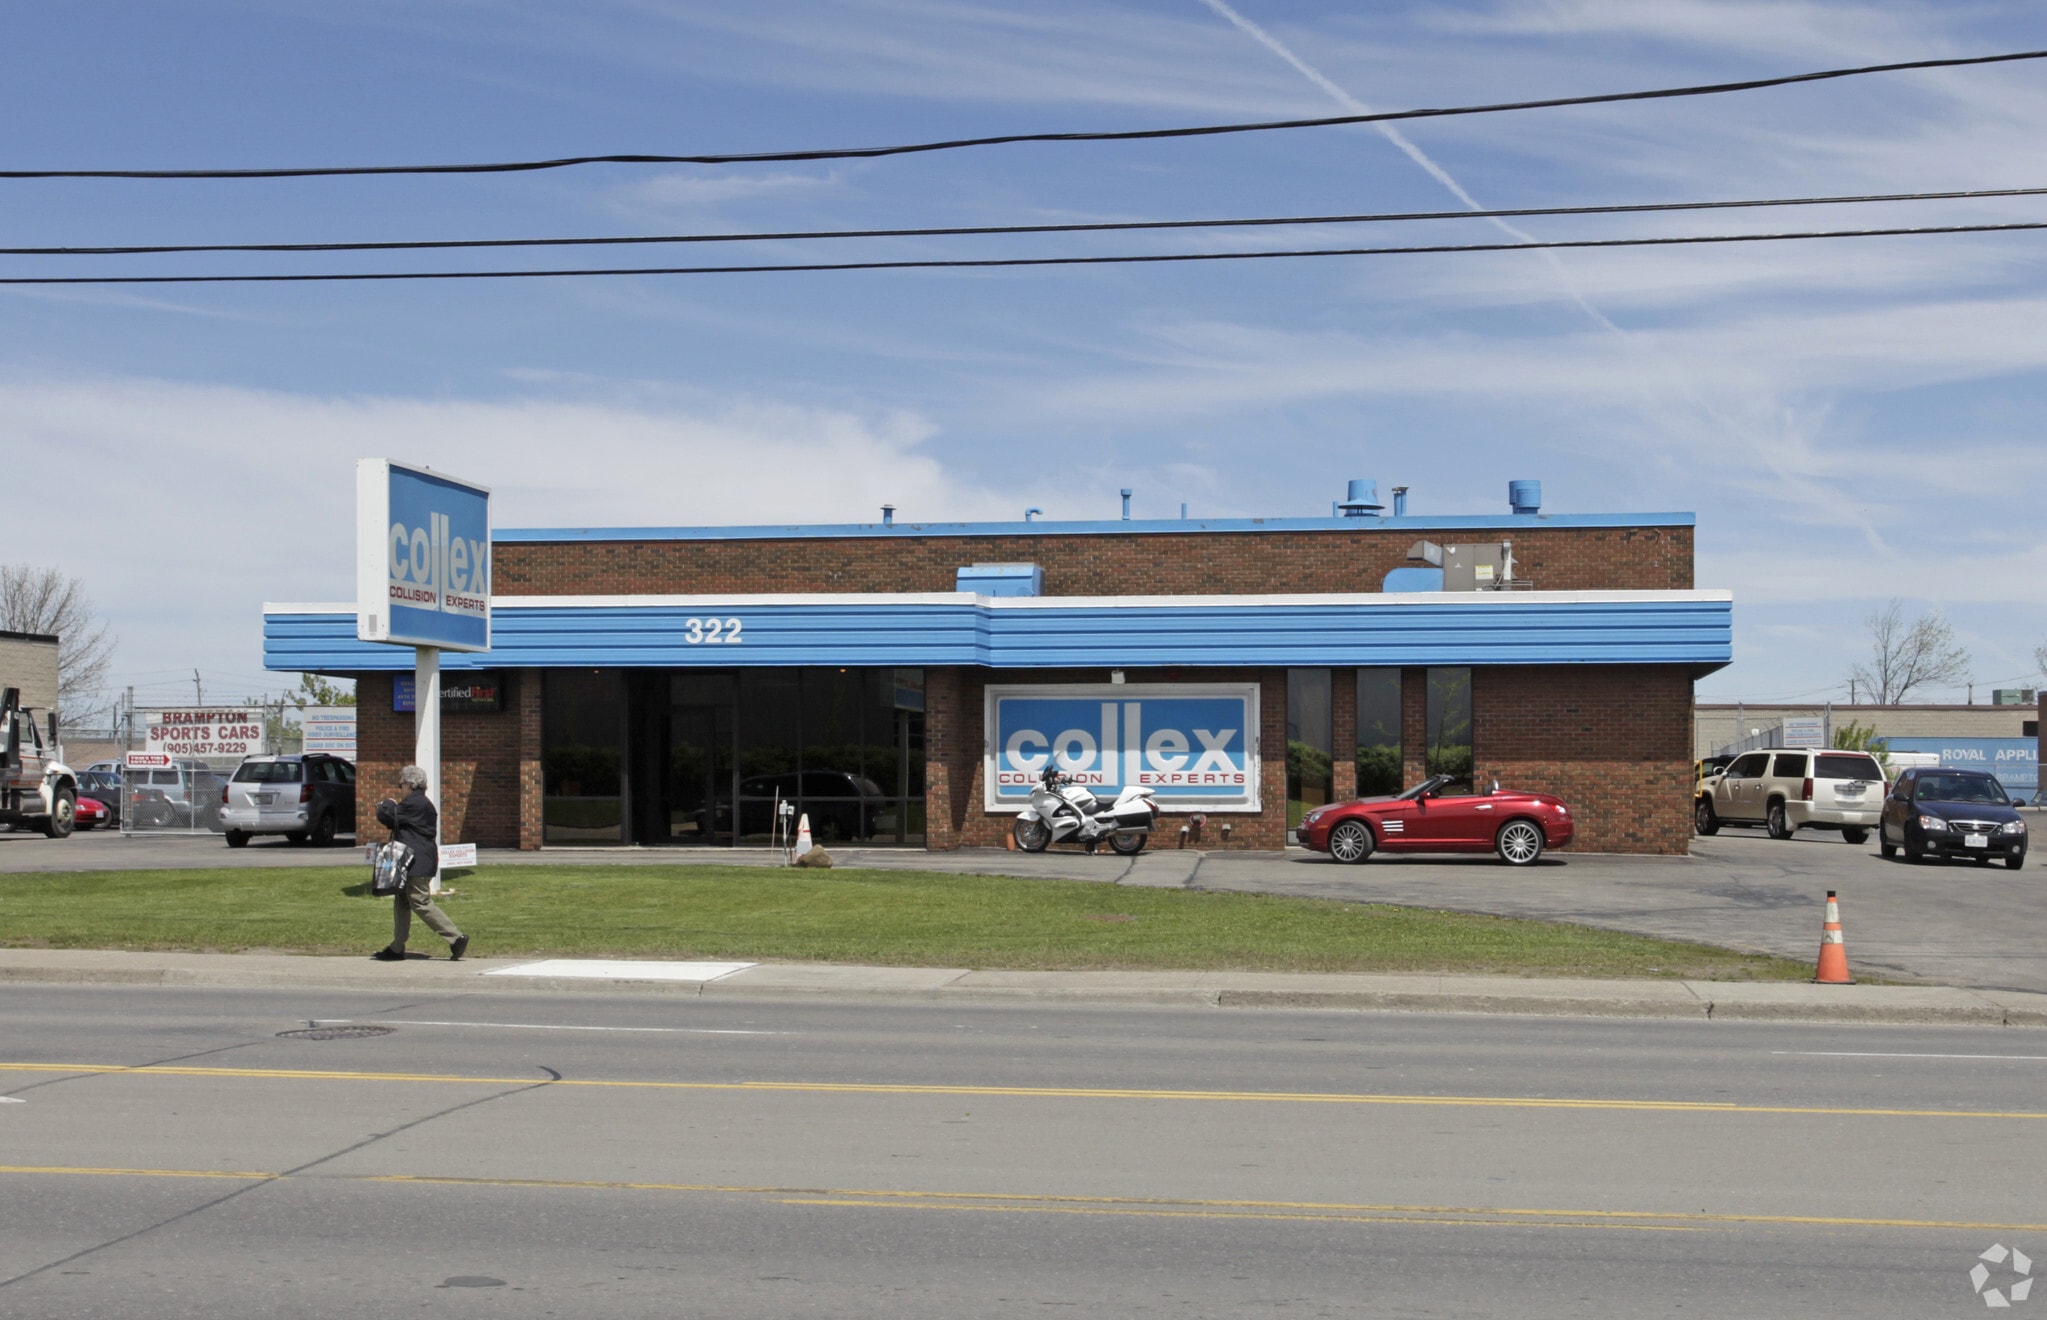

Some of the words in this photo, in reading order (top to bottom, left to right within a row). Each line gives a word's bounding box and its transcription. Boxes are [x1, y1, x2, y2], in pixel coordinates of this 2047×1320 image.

[390, 511, 487, 594] collex
[389, 585, 437, 603] COLLISION
[446, 594, 486, 611] EXPERTS
[685, 618, 742, 643] 322
[162, 711, 248, 724] BRAMPTON
[150, 726, 211, 741] SPORTS
[218, 725, 260, 740] CARS
[1006, 702, 1238, 773] collex
[163, 742, 247, 756] (905)457-9229
[1942, 749, 1987, 761] ROYAL
[999, 773, 1103, 784] COLION
[1139, 773, 1245, 784] EXPERTS
